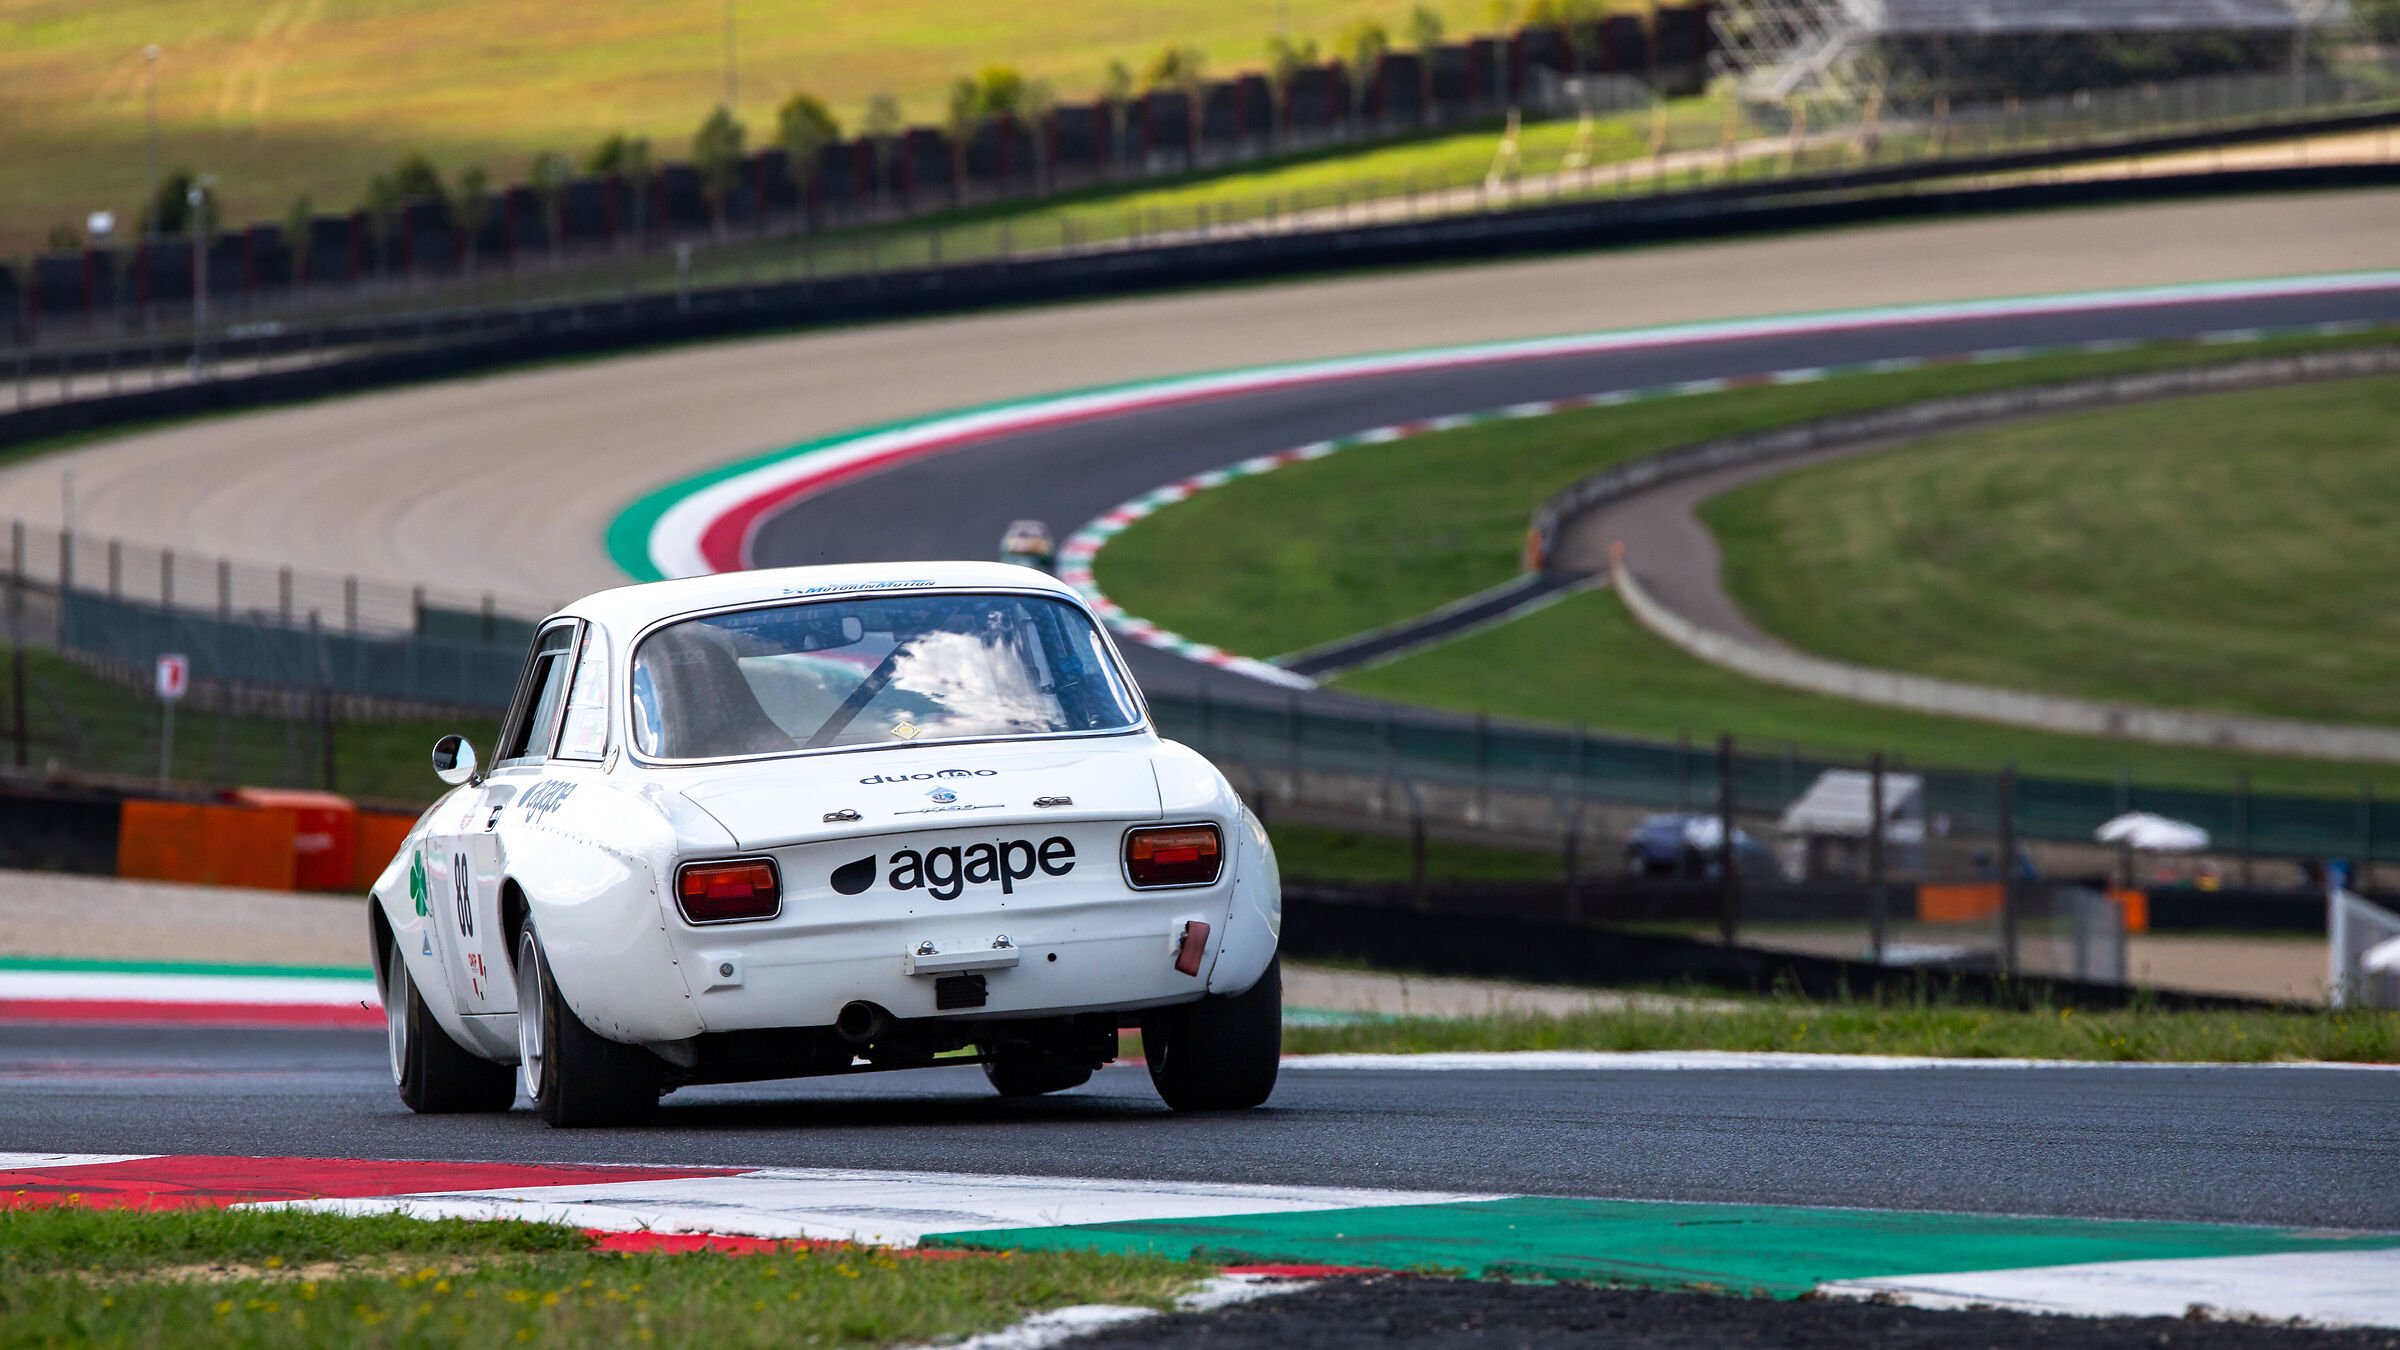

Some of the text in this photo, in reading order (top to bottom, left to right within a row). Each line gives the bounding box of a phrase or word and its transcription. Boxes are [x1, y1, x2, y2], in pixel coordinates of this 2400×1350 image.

[525, 779, 578, 825] agape
[858, 768, 998, 785] duomo
[454, 852, 474, 938] 88
[888, 835, 1076, 901] agape
